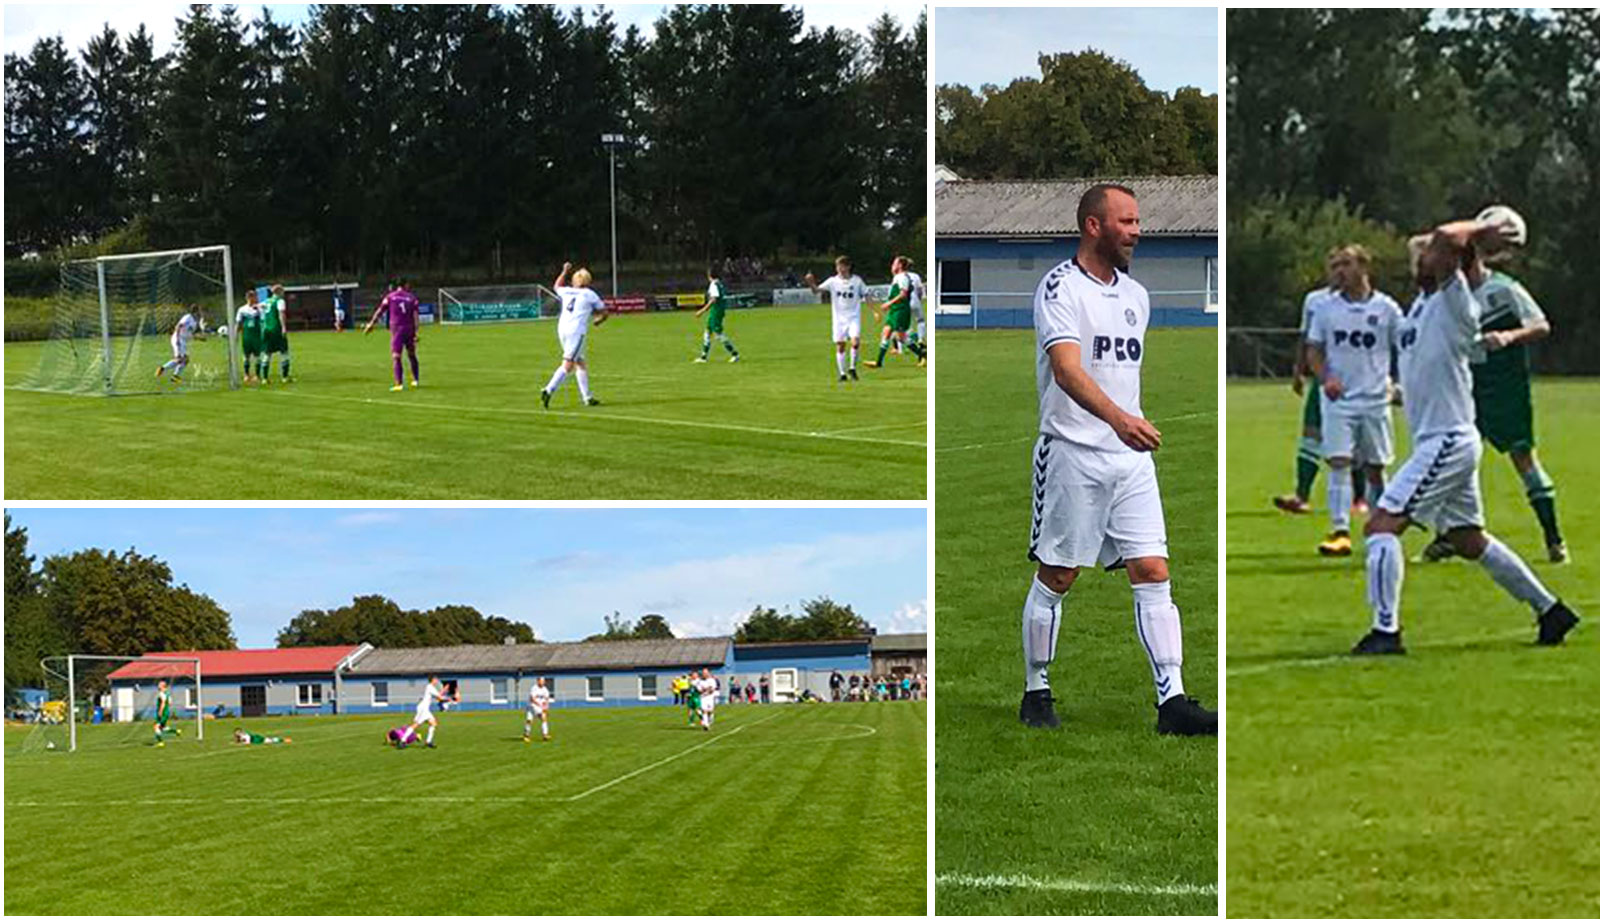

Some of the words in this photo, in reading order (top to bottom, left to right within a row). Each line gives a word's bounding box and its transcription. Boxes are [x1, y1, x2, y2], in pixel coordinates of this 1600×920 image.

[398, 302, 406, 313] 1
[566, 297, 576, 312] 4
[1333, 330, 1376, 349] PCO
[1092, 335, 1142, 362] PCO
